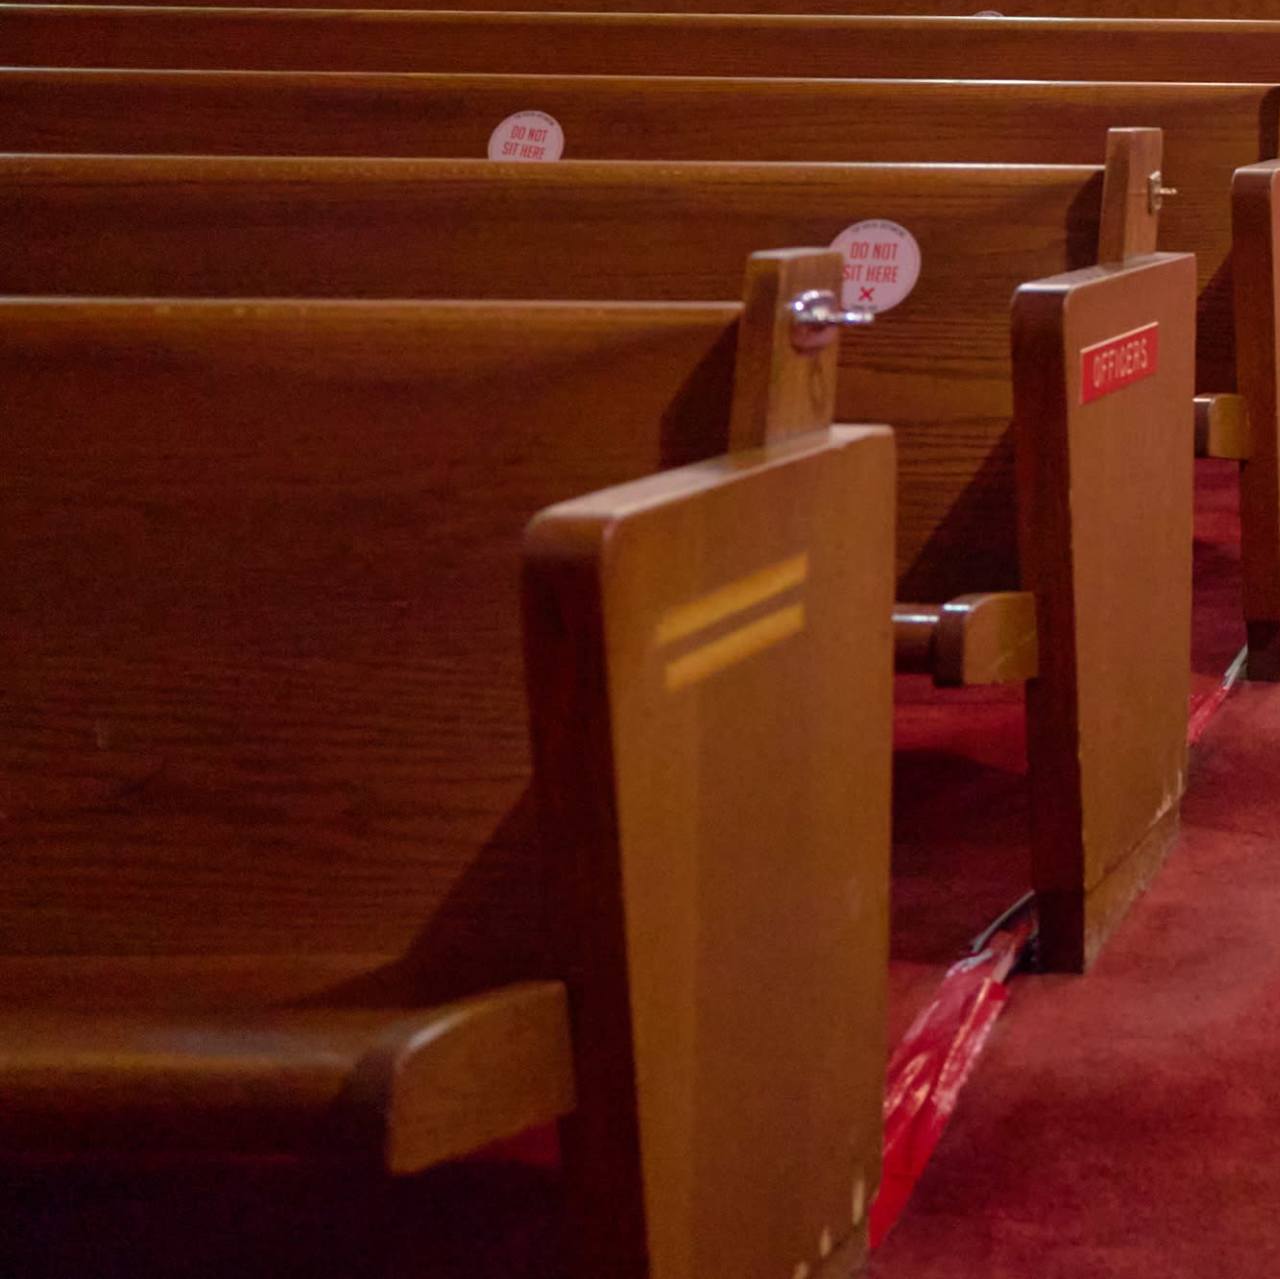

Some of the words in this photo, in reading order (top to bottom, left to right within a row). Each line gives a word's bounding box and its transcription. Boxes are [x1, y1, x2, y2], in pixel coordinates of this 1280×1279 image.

[510, 125, 526, 140] DO
[528, 127, 549, 143] NOT
[502, 142, 518, 156] SIT
[520, 144, 546, 160] HERE
[850, 241, 869, 260] DO
[872, 243, 899, 261] NOT
[843, 265, 864, 281] SIT
[866, 266, 899, 283] HERE
[1092, 337, 1148, 388] OFFICERS
